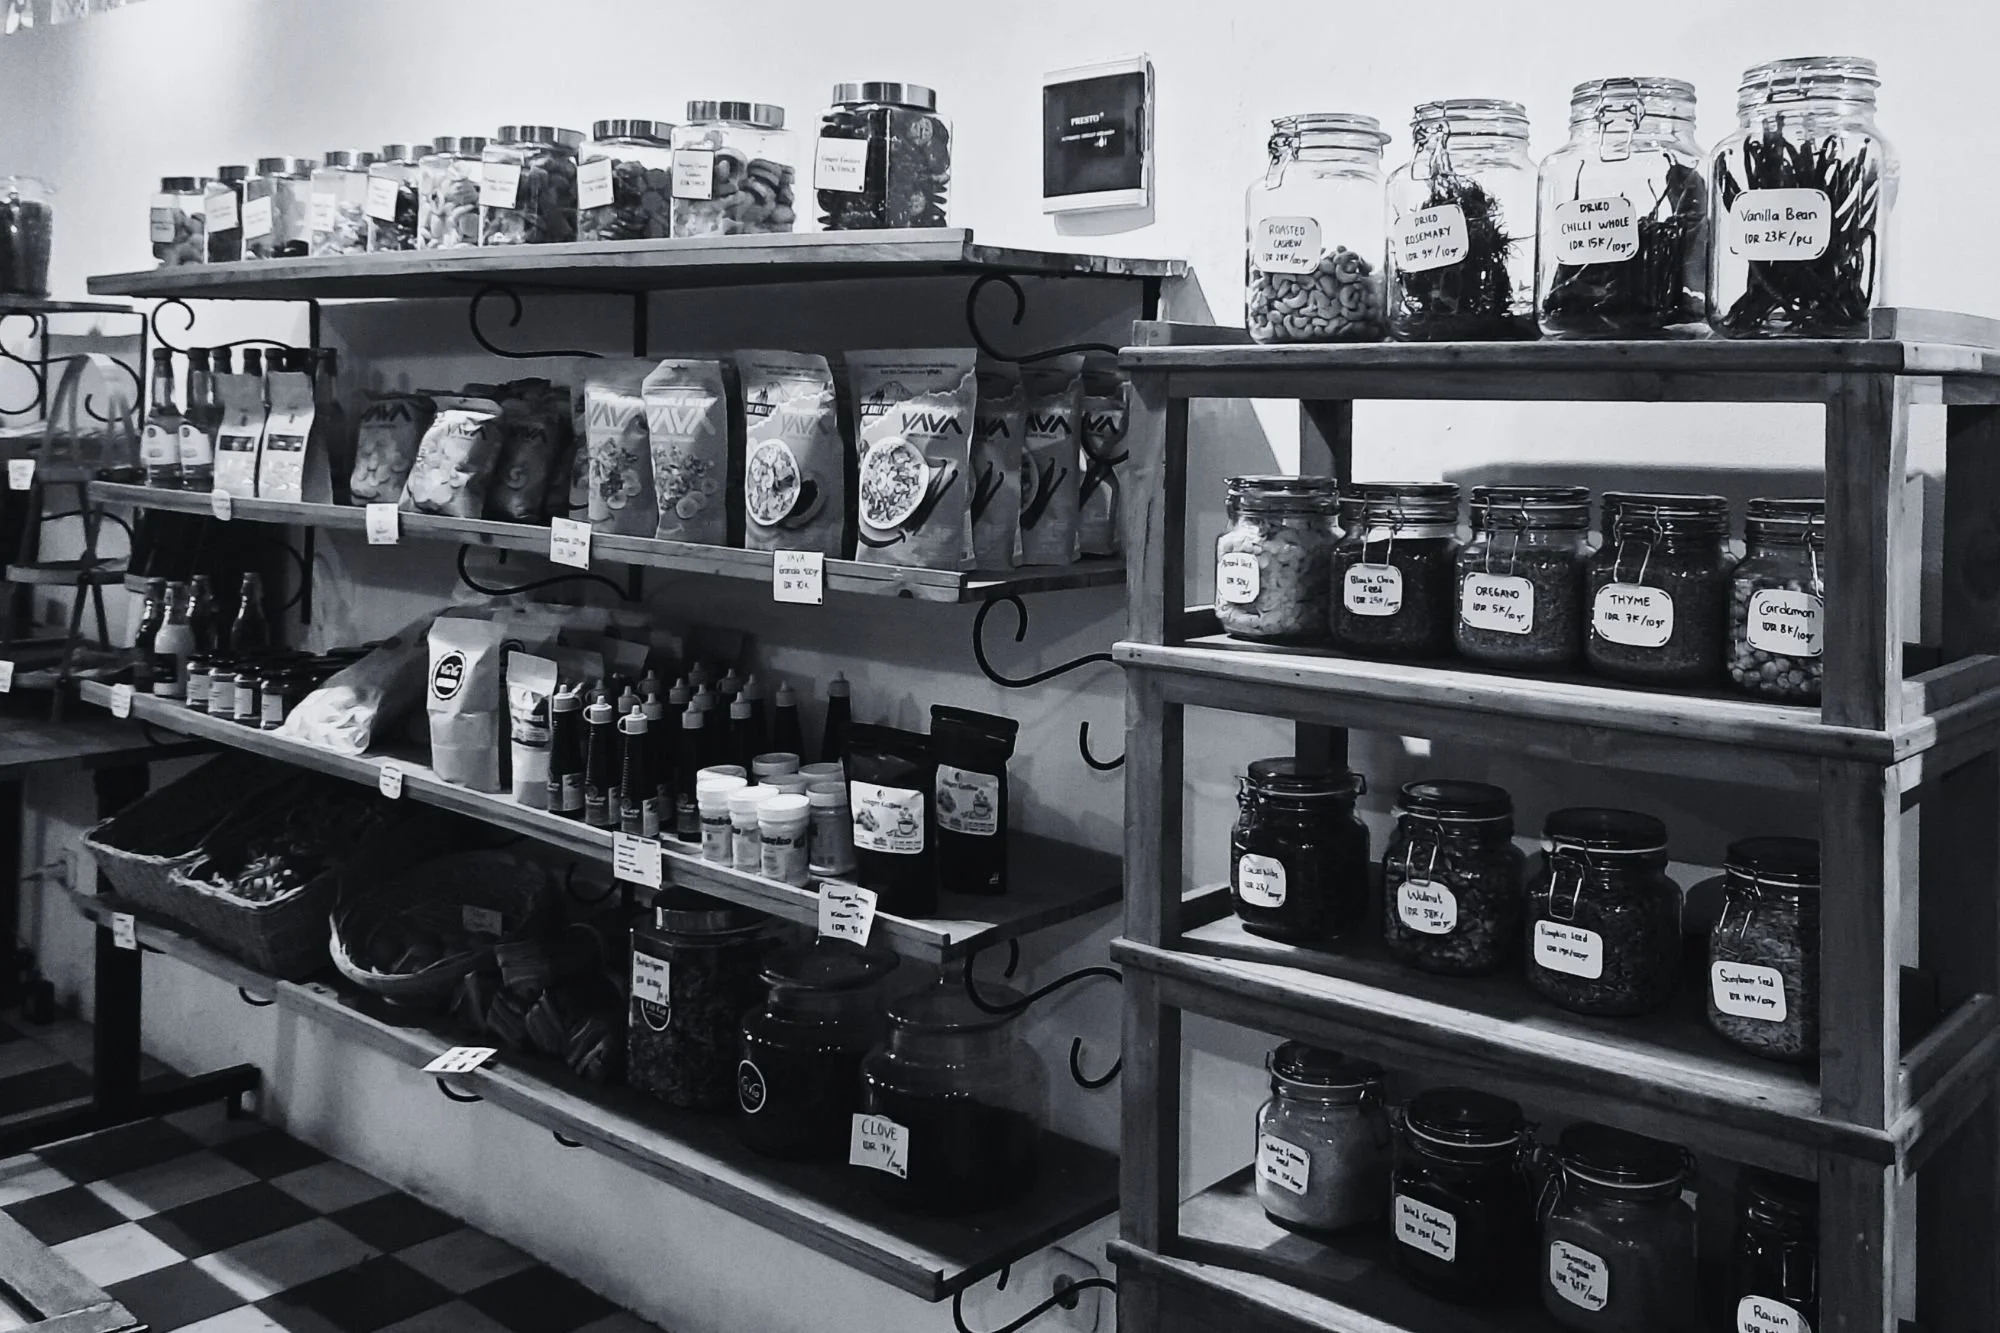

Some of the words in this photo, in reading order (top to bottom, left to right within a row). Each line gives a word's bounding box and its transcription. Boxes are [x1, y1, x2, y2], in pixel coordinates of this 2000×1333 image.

[1579, 201, 1610, 214] DRIED
[1740, 207, 1780, 222] Vanilla
[1785, 206, 1818, 221] Bean
[1414, 213, 1439, 228] DRIED
[1561, 220, 1592, 235] CHILLI
[1598, 215, 1630, 230] WHOLE
[1268, 223, 1306, 237] ROASTED
[1404, 225, 1452, 246] ROSEMARY
[1272, 239, 1303, 249] CASHEW
[1569, 239, 1585, 251] IDR
[1744, 231, 1761, 245] IDR
[1405, 251, 1419, 262] IDR
[779, 414, 829, 437] YAVA
[900, 412, 963, 436] YAVA
[1475, 585, 1520, 599] OREGANO
[1472, 602, 1487, 611] IDR
[1609, 594, 1651, 608] THYME
[1604, 611, 1621, 621] IDR
[1762, 621, 1777, 631] IDR
[1406, 889, 1444, 904] Walnut
[861, 1118, 898, 1141] CLOVE
[1752, 1304, 1789, 1327] Raisin
